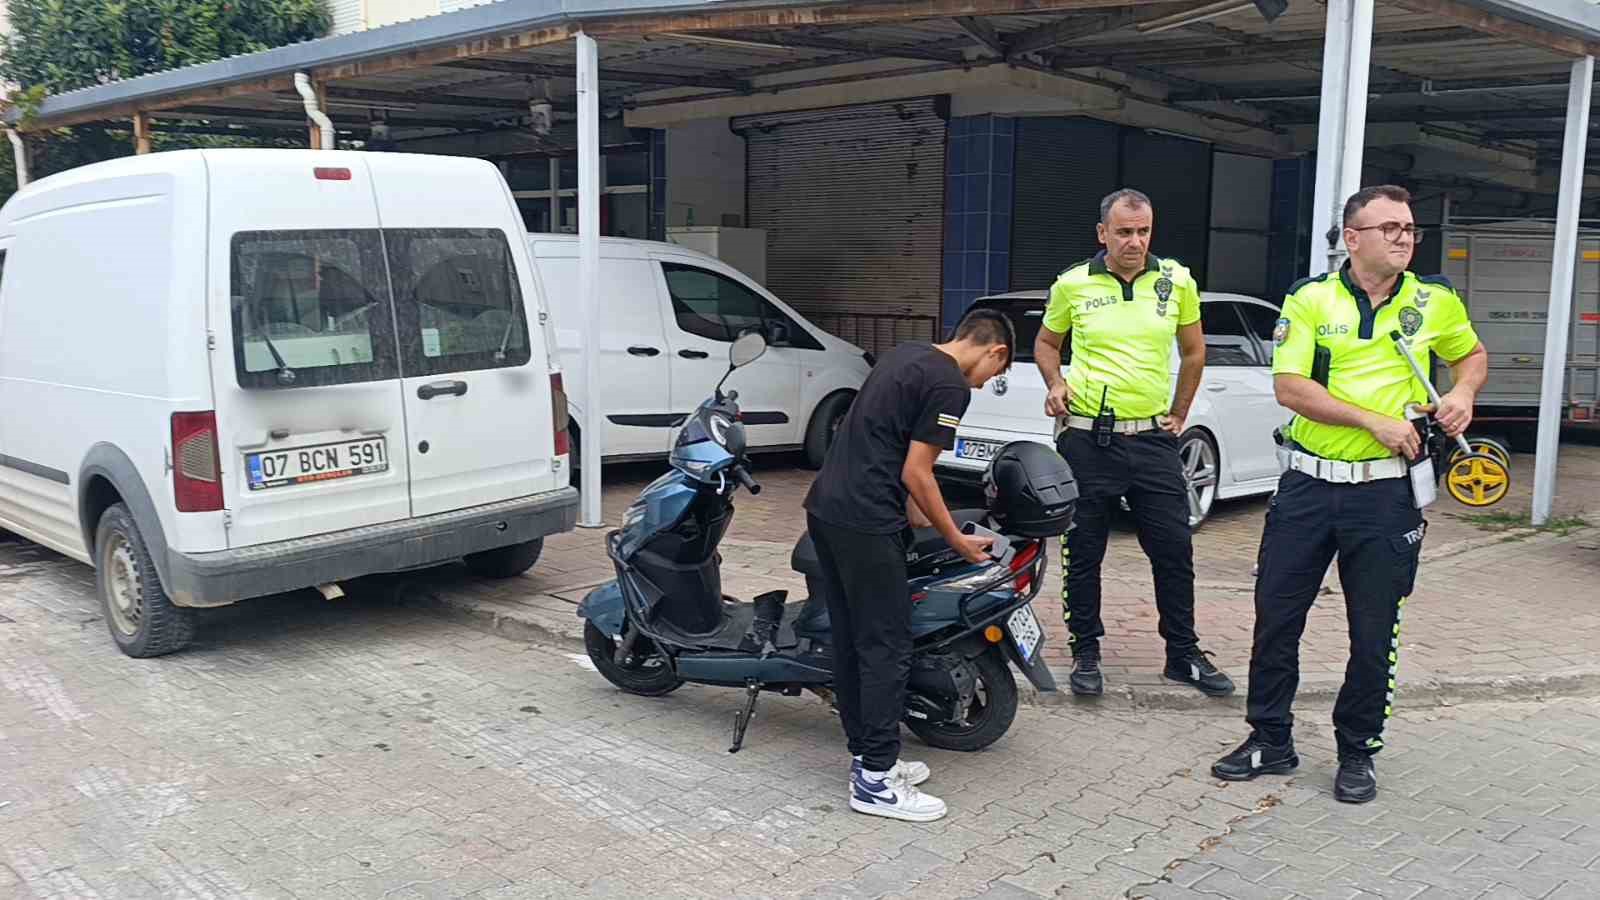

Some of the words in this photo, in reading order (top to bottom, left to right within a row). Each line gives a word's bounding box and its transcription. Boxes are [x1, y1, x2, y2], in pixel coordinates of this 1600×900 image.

[262, 454, 288, 477] 07
[299, 448, 339, 472] BCN
[350, 442, 384, 466] 591
